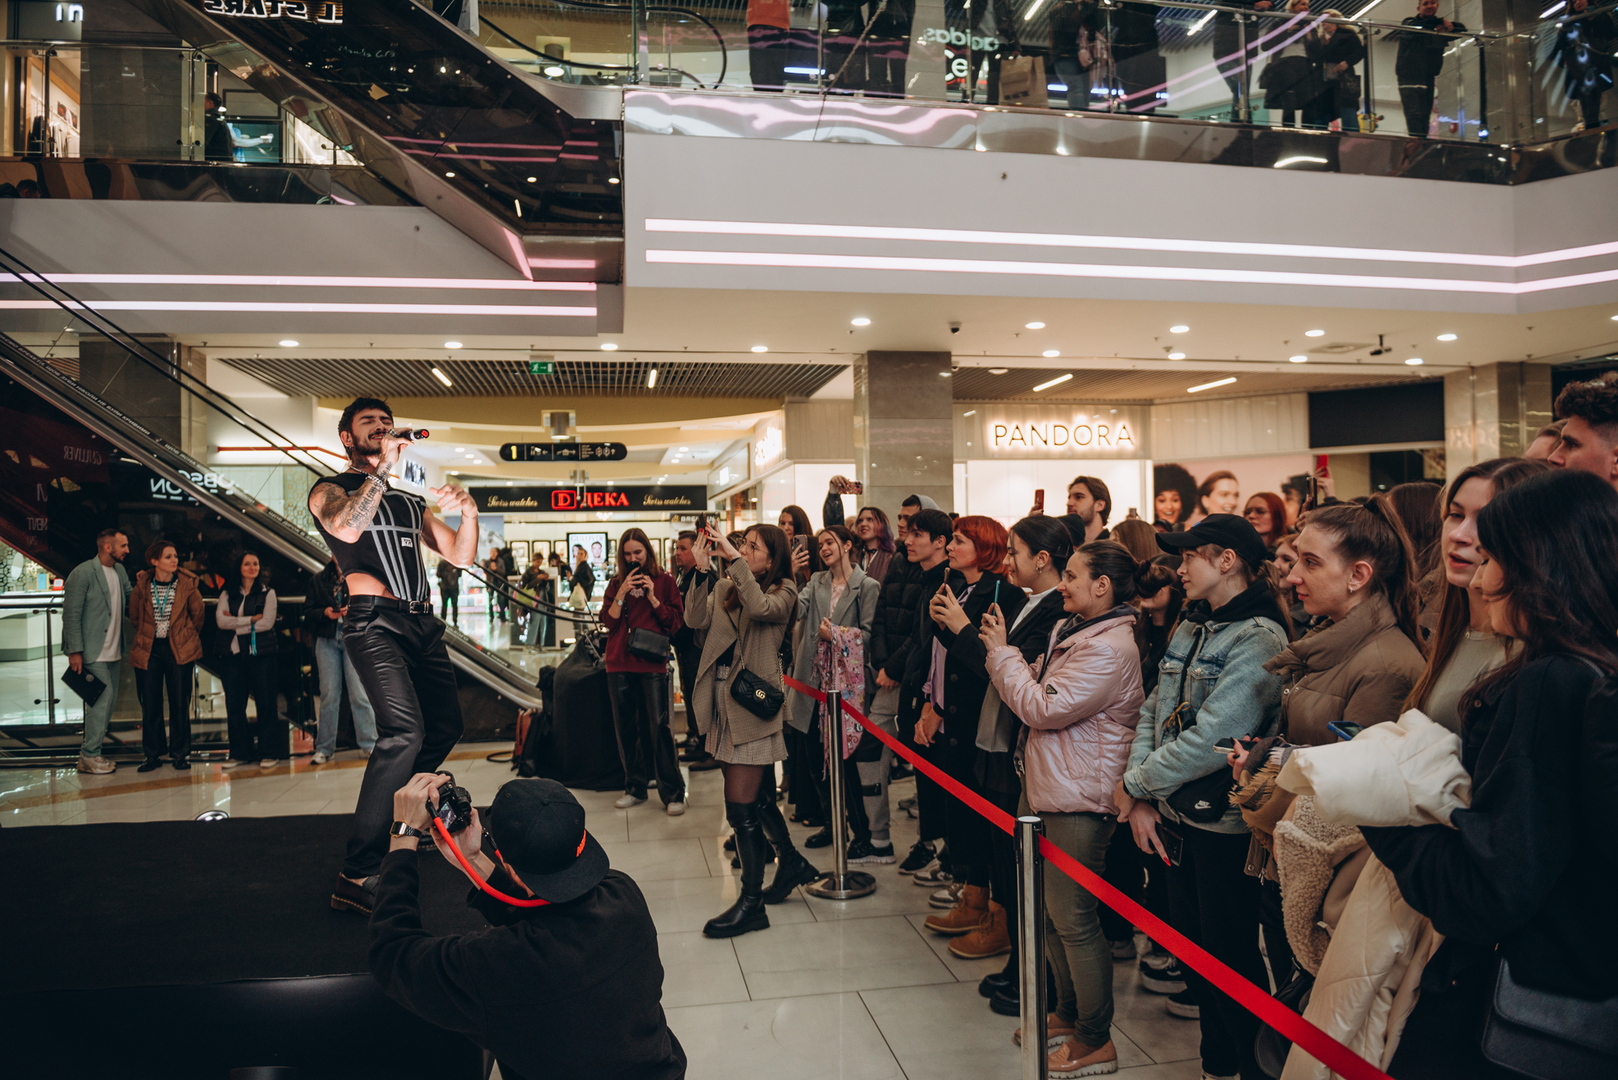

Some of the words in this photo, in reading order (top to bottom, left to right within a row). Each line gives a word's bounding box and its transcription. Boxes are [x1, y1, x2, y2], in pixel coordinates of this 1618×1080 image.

[994, 424, 1135, 446] PANDORA
[510, 445, 517, 460] 1
[487, 494, 509, 507] Swiss
[509, 496, 538, 507] watches
[580, 492, 630, 509] ДЕКА
[643, 493, 663, 506] Swiss
[663, 495, 691, 506] watches
